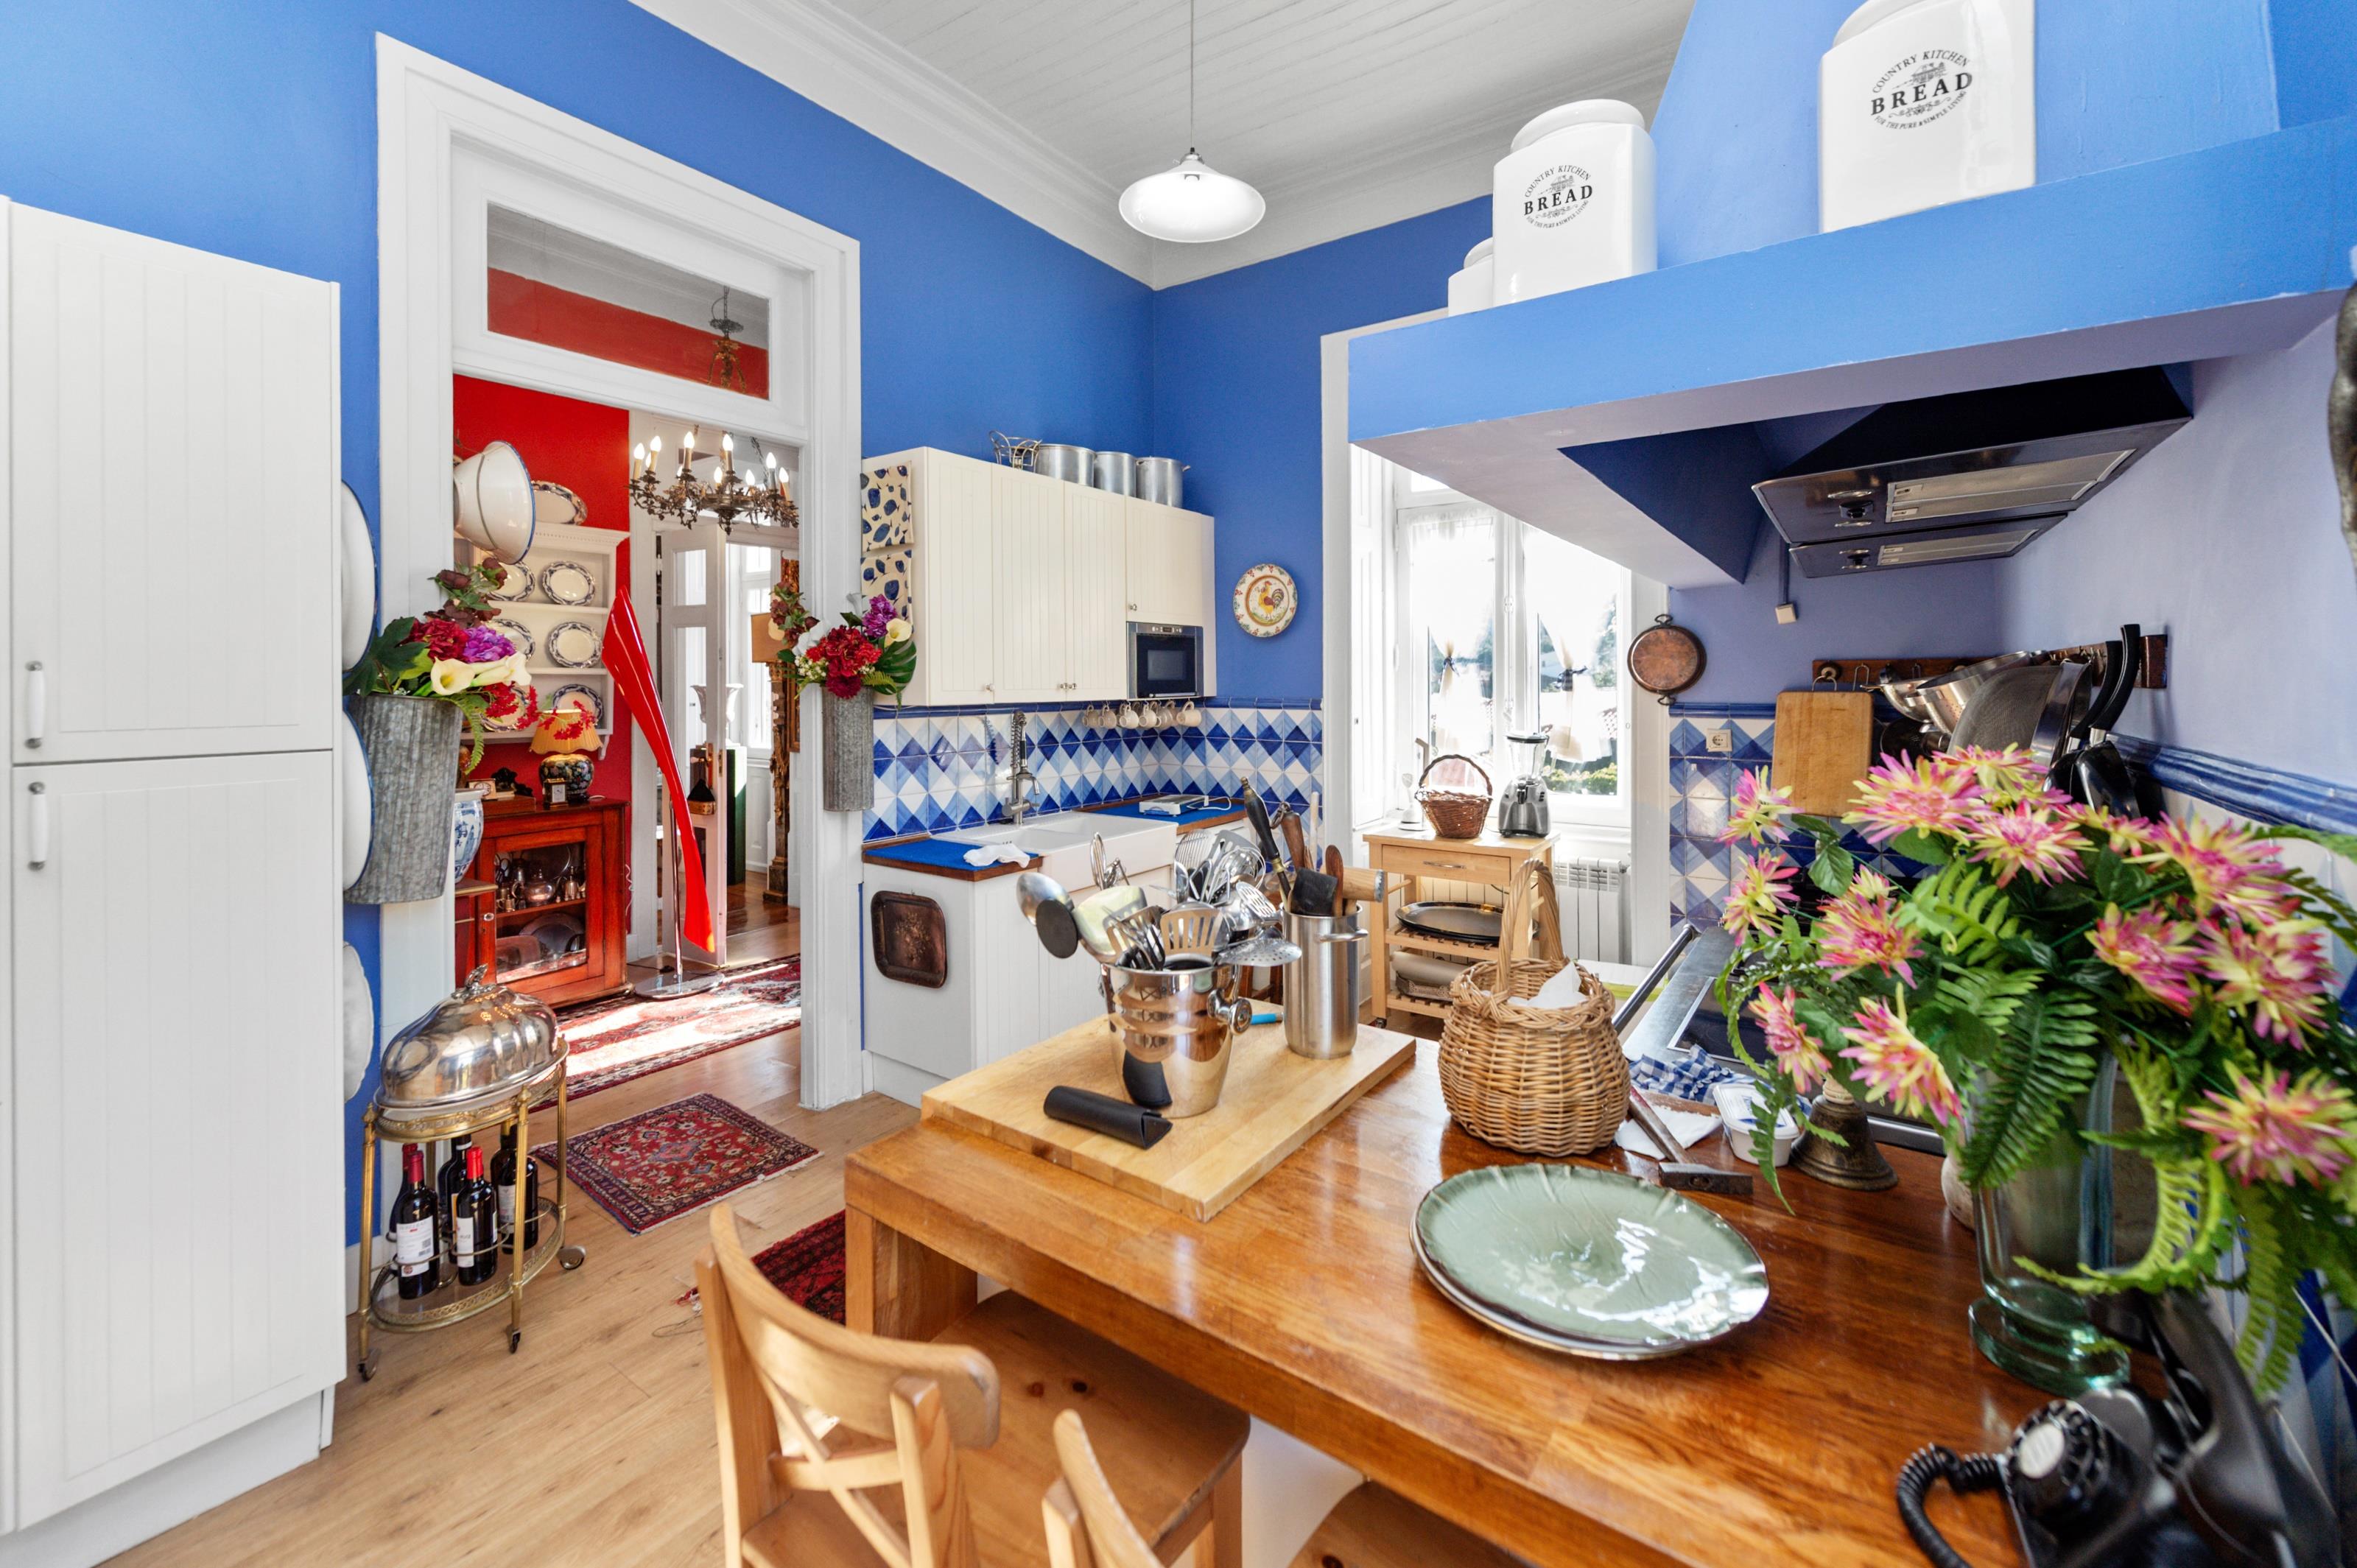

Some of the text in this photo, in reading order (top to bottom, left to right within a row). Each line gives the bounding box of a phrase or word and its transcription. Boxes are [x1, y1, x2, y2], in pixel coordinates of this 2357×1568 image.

[1872, 49, 1970, 94] COUNTRY KITCHEN
[1870, 72, 1973, 116] BREAD
[1899, 122, 1916, 130] PURE
[1923, 109, 1947, 124] SIMPLE
[1525, 165, 1591, 197] COUNTRY KITCHEN
[1524, 185, 1592, 216] BREAD
